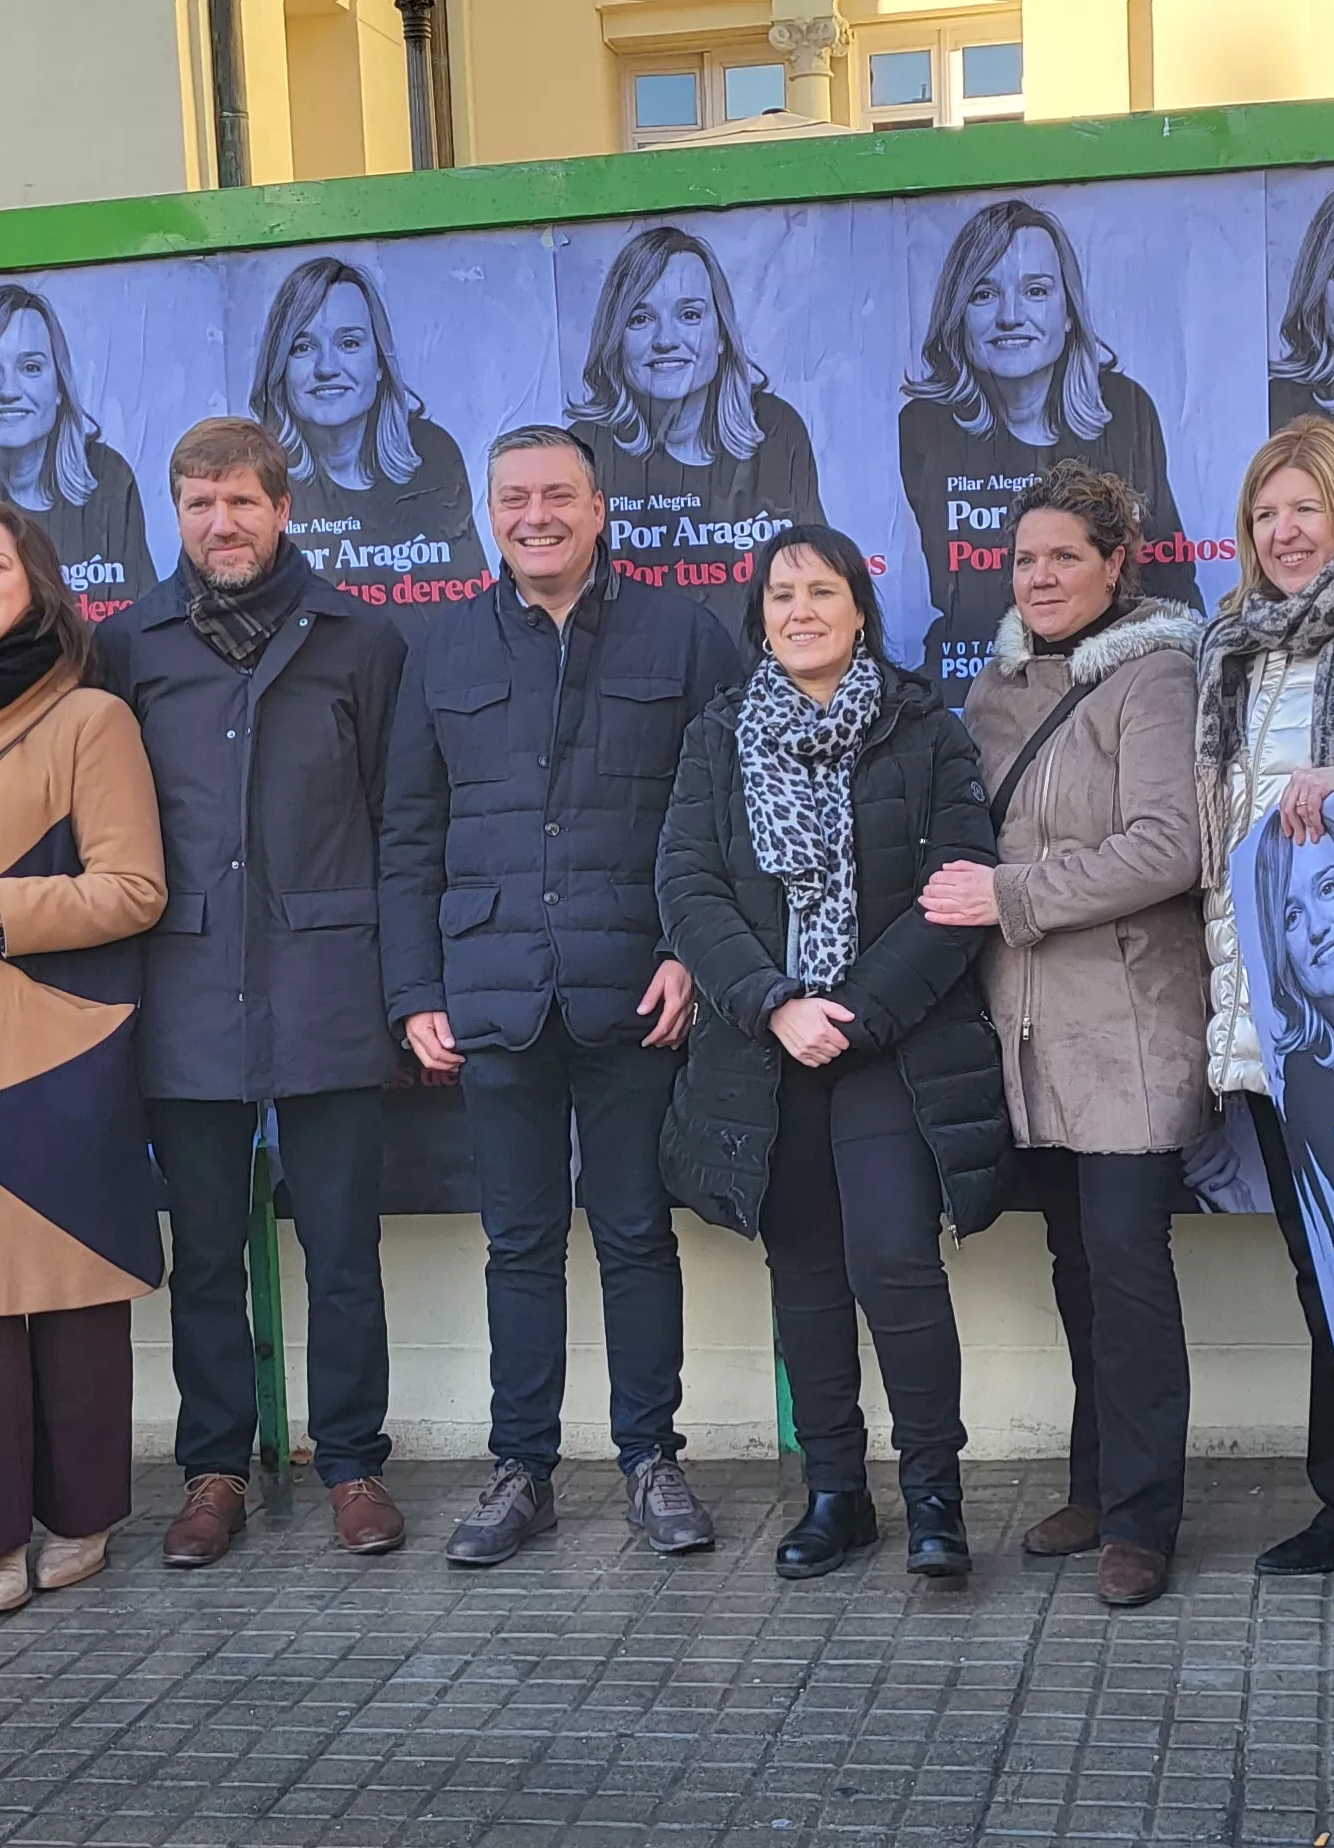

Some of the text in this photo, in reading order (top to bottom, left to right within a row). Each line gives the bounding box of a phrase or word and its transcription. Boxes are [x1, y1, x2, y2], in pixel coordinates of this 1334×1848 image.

[947, 476, 984, 492] Pilar
[609, 493, 701, 511] Pilar Alegría
[947, 500, 1008, 530] Por
[311, 516, 362, 534] Alegría
[609, 520, 667, 550] Por
[335, 533, 450, 572] Aragón
[948, 531, 1236, 571] Por echos
[674, 558, 727, 586] tus
